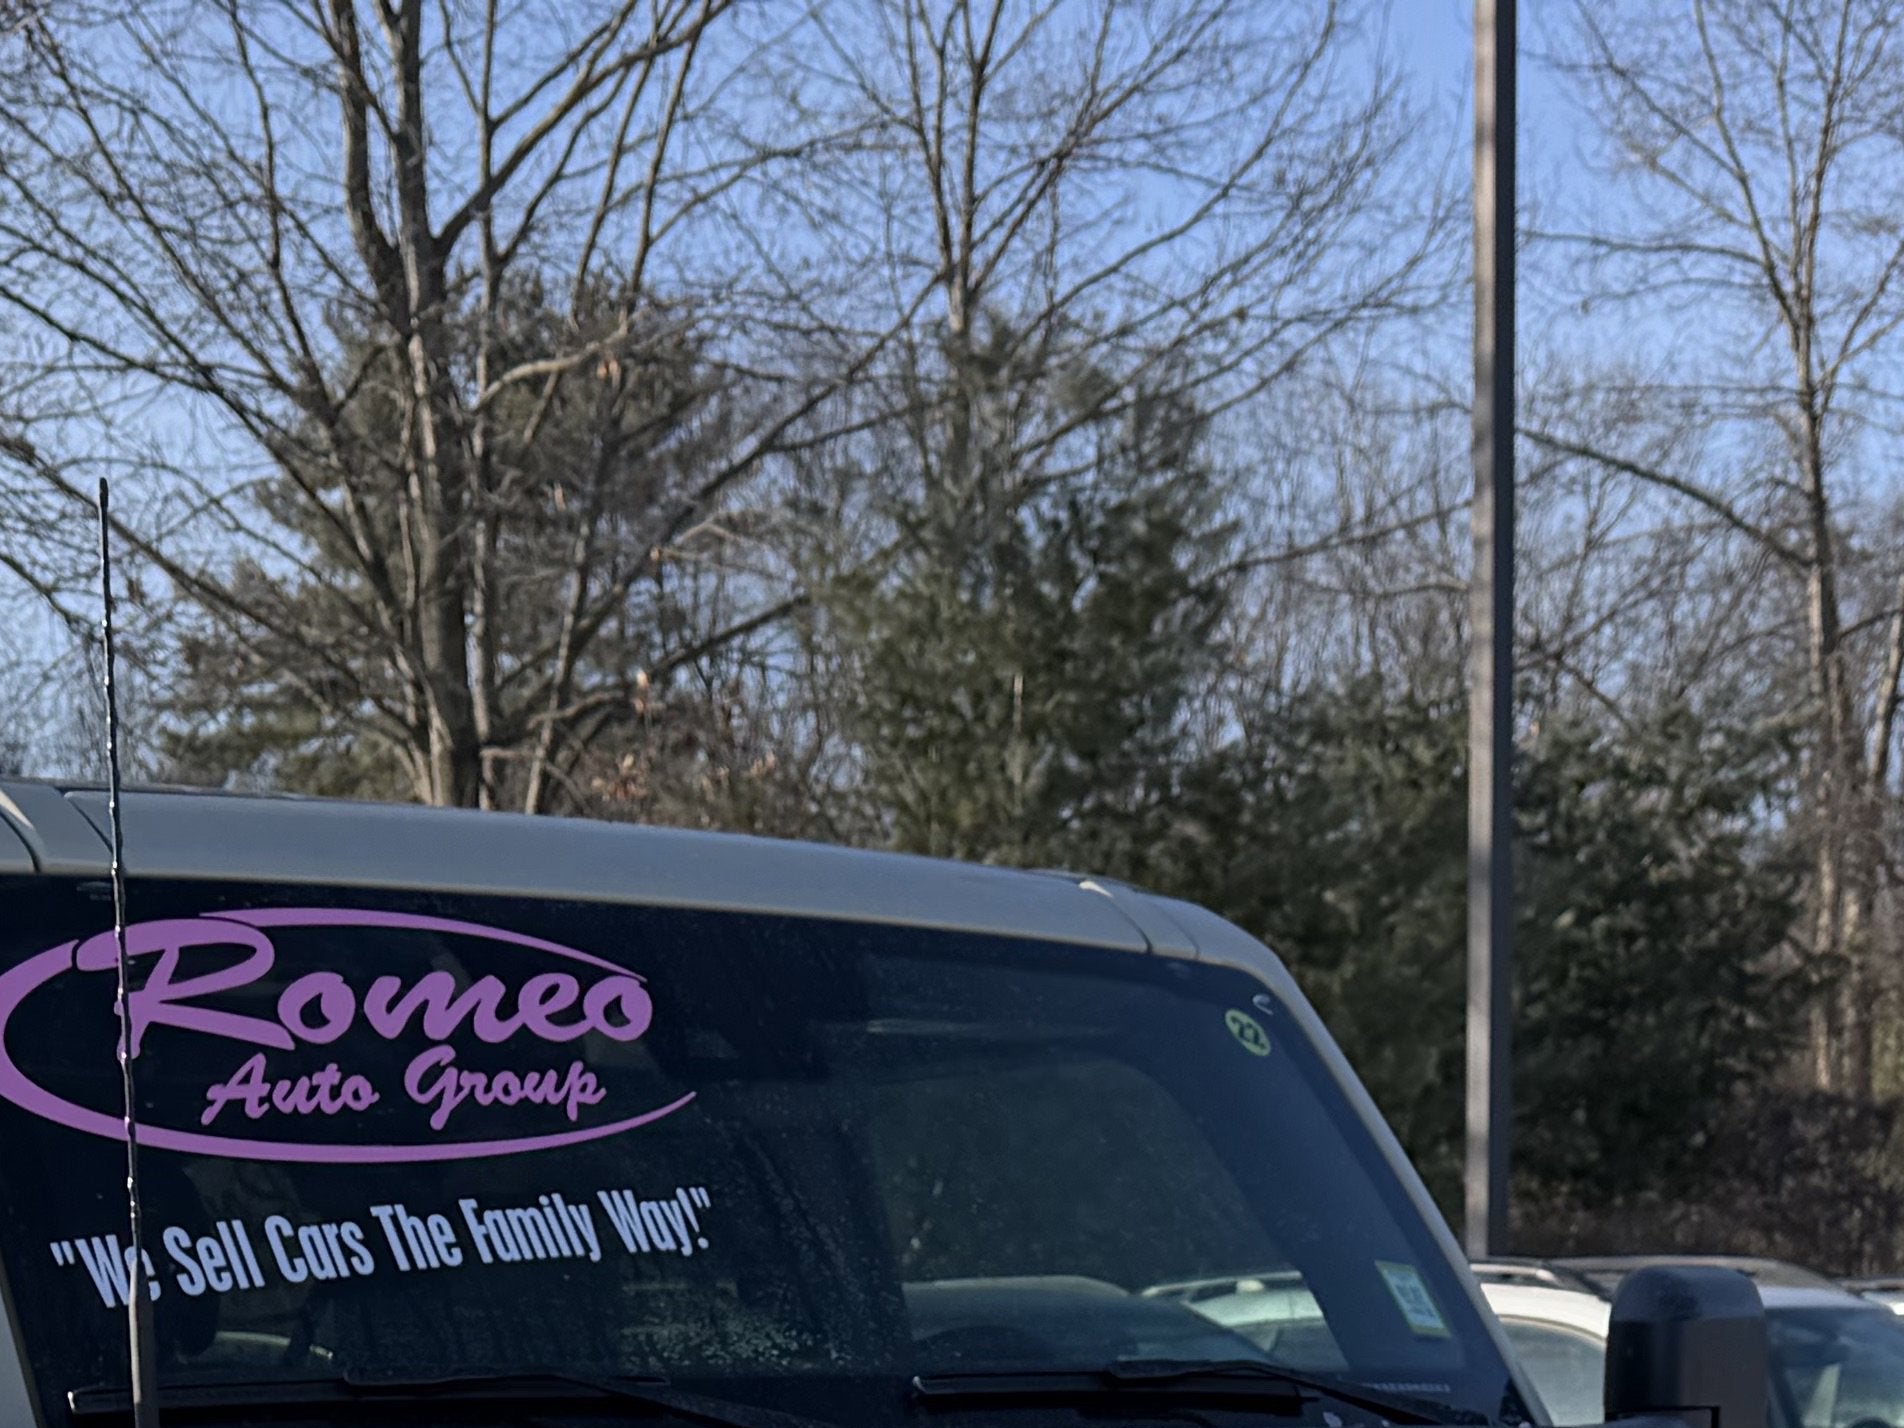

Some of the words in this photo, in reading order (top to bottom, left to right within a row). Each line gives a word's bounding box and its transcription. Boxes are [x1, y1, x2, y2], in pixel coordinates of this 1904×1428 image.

[76, 914, 653, 1059] Romeo
[200, 1052, 380, 1126] Auto
[403, 1044, 607, 1131] Group
[162, 1218, 266, 1297] Sell
[263, 1214, 375, 1283] Cars
[369, 1203, 463, 1271] The
[458, 1193, 602, 1263] Family
[596, 1186, 712, 1257] Way!"
